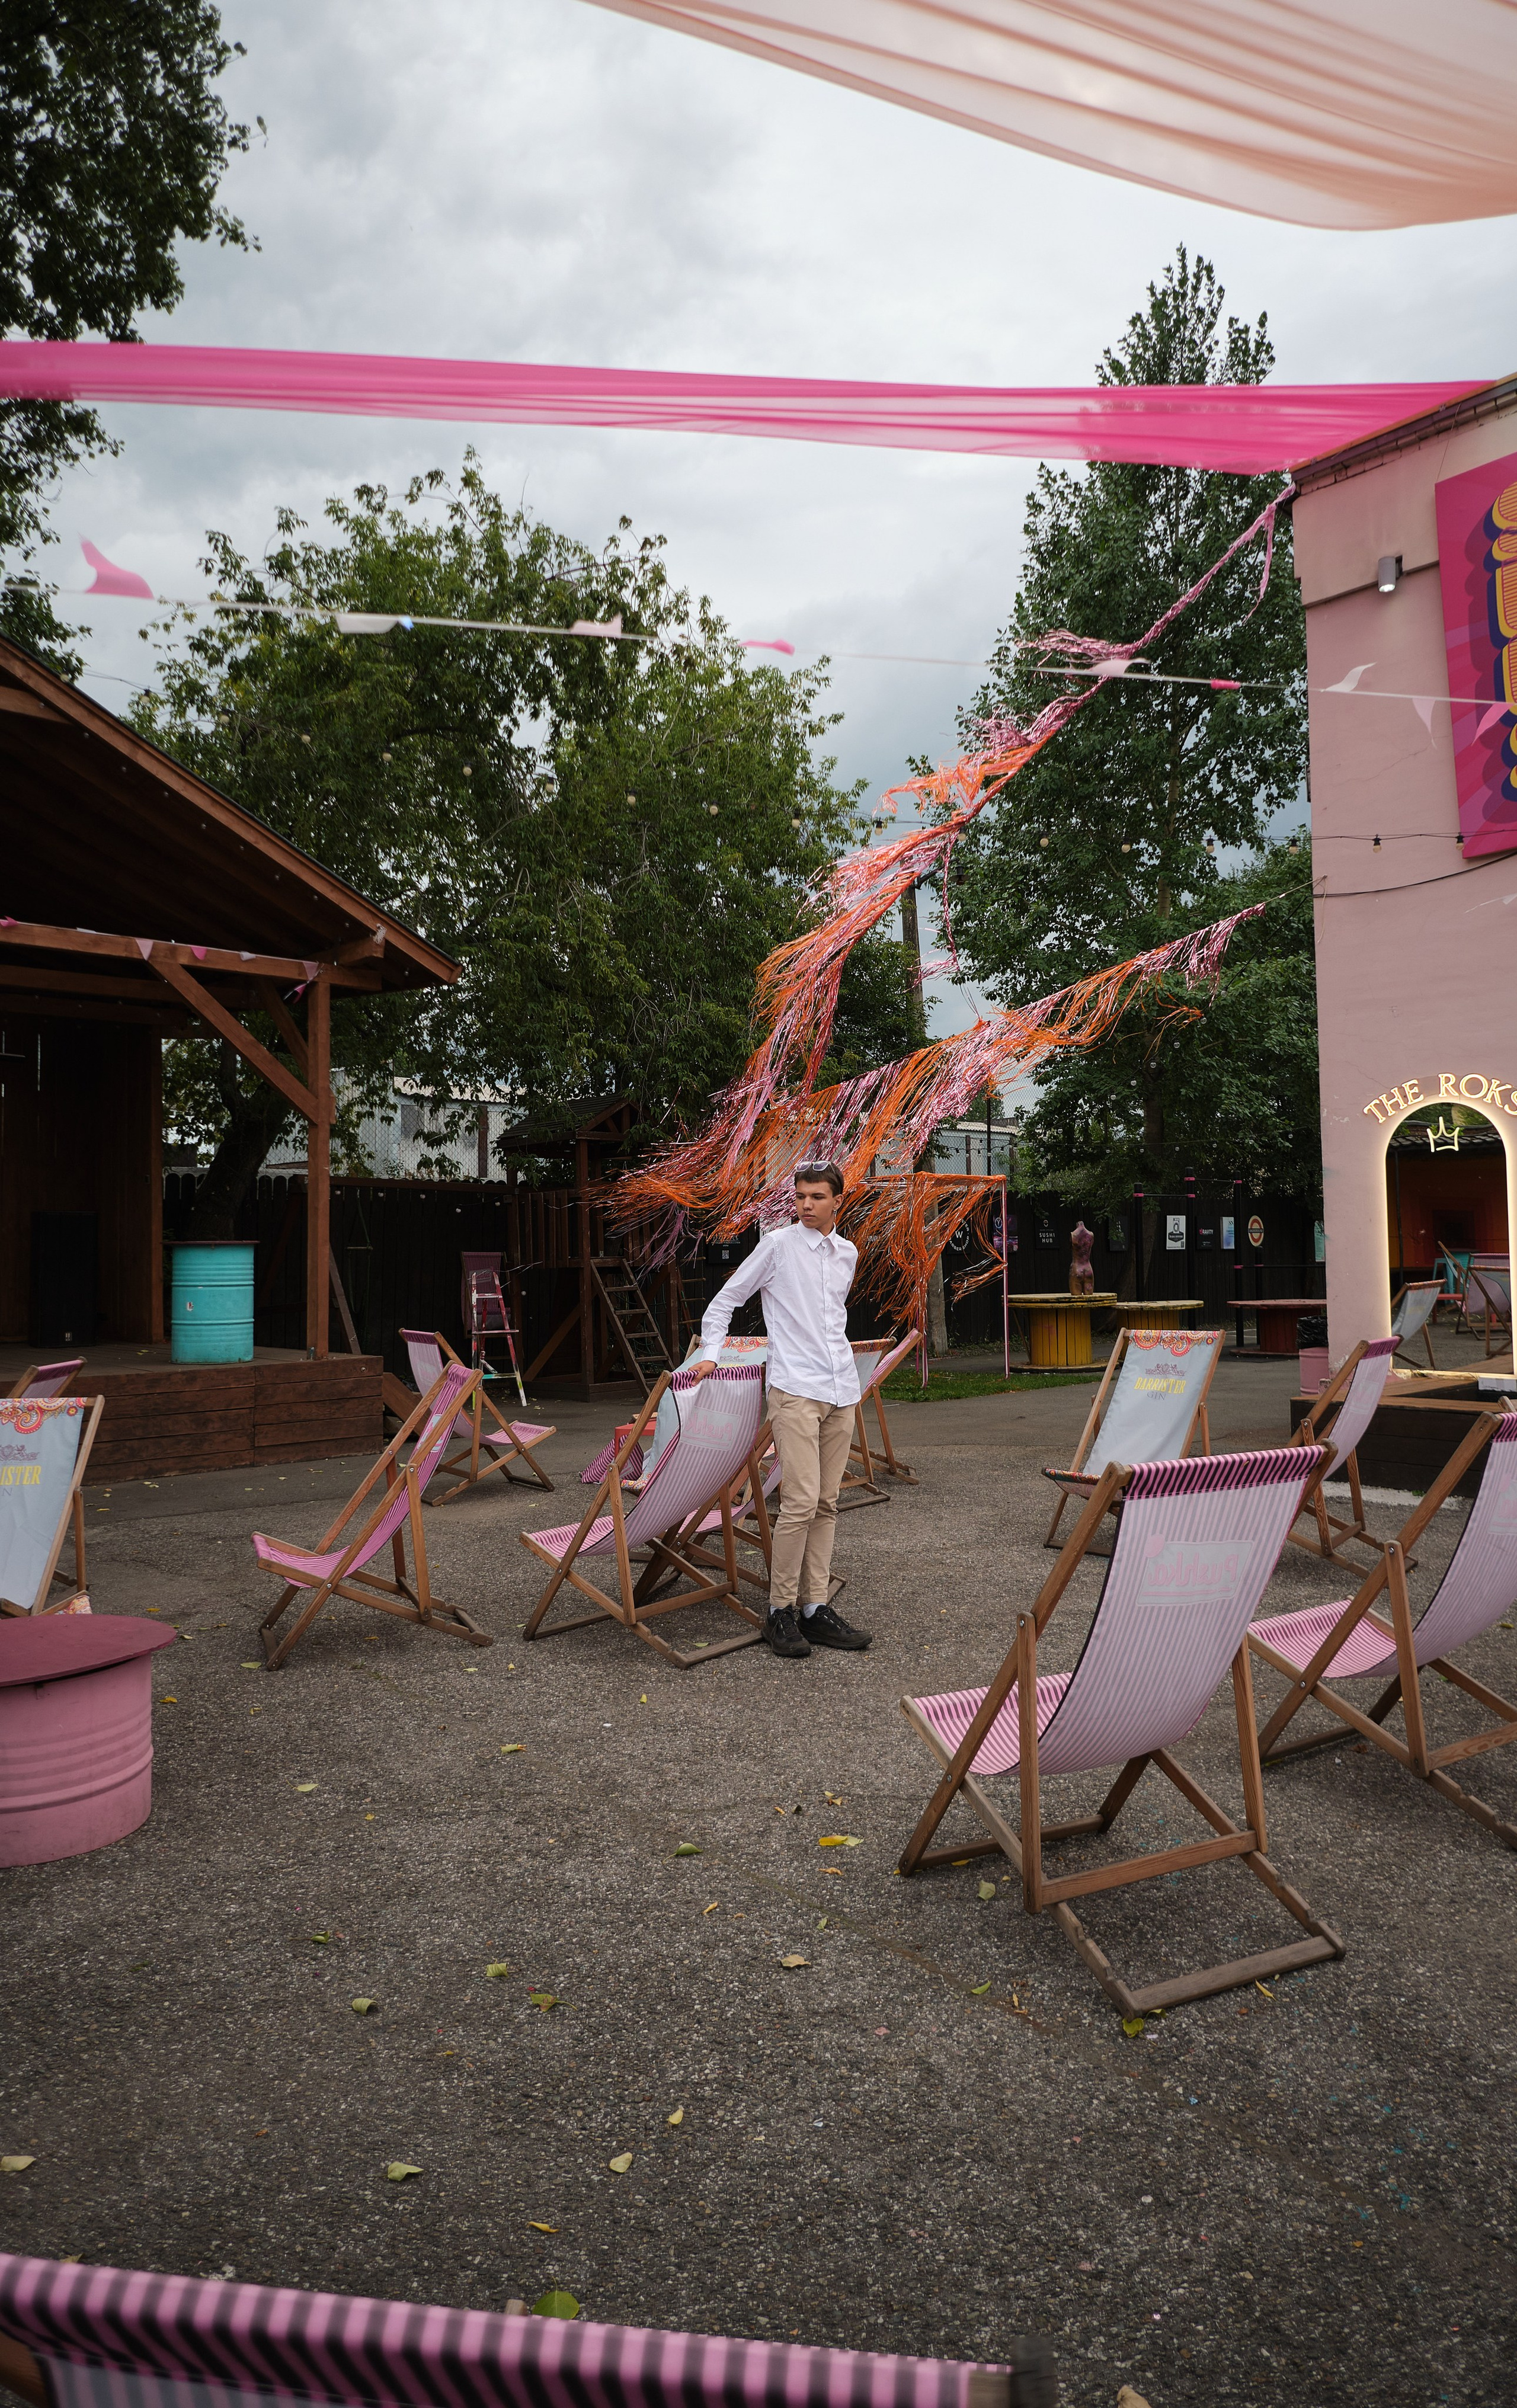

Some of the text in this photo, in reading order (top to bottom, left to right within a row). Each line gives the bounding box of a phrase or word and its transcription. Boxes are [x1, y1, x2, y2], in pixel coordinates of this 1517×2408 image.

[1363, 1073, 1517, 1124] THE ROKS
[1134, 1377, 1186, 1394] BARRISTER
[1147, 1391, 1166, 1400] GIN
